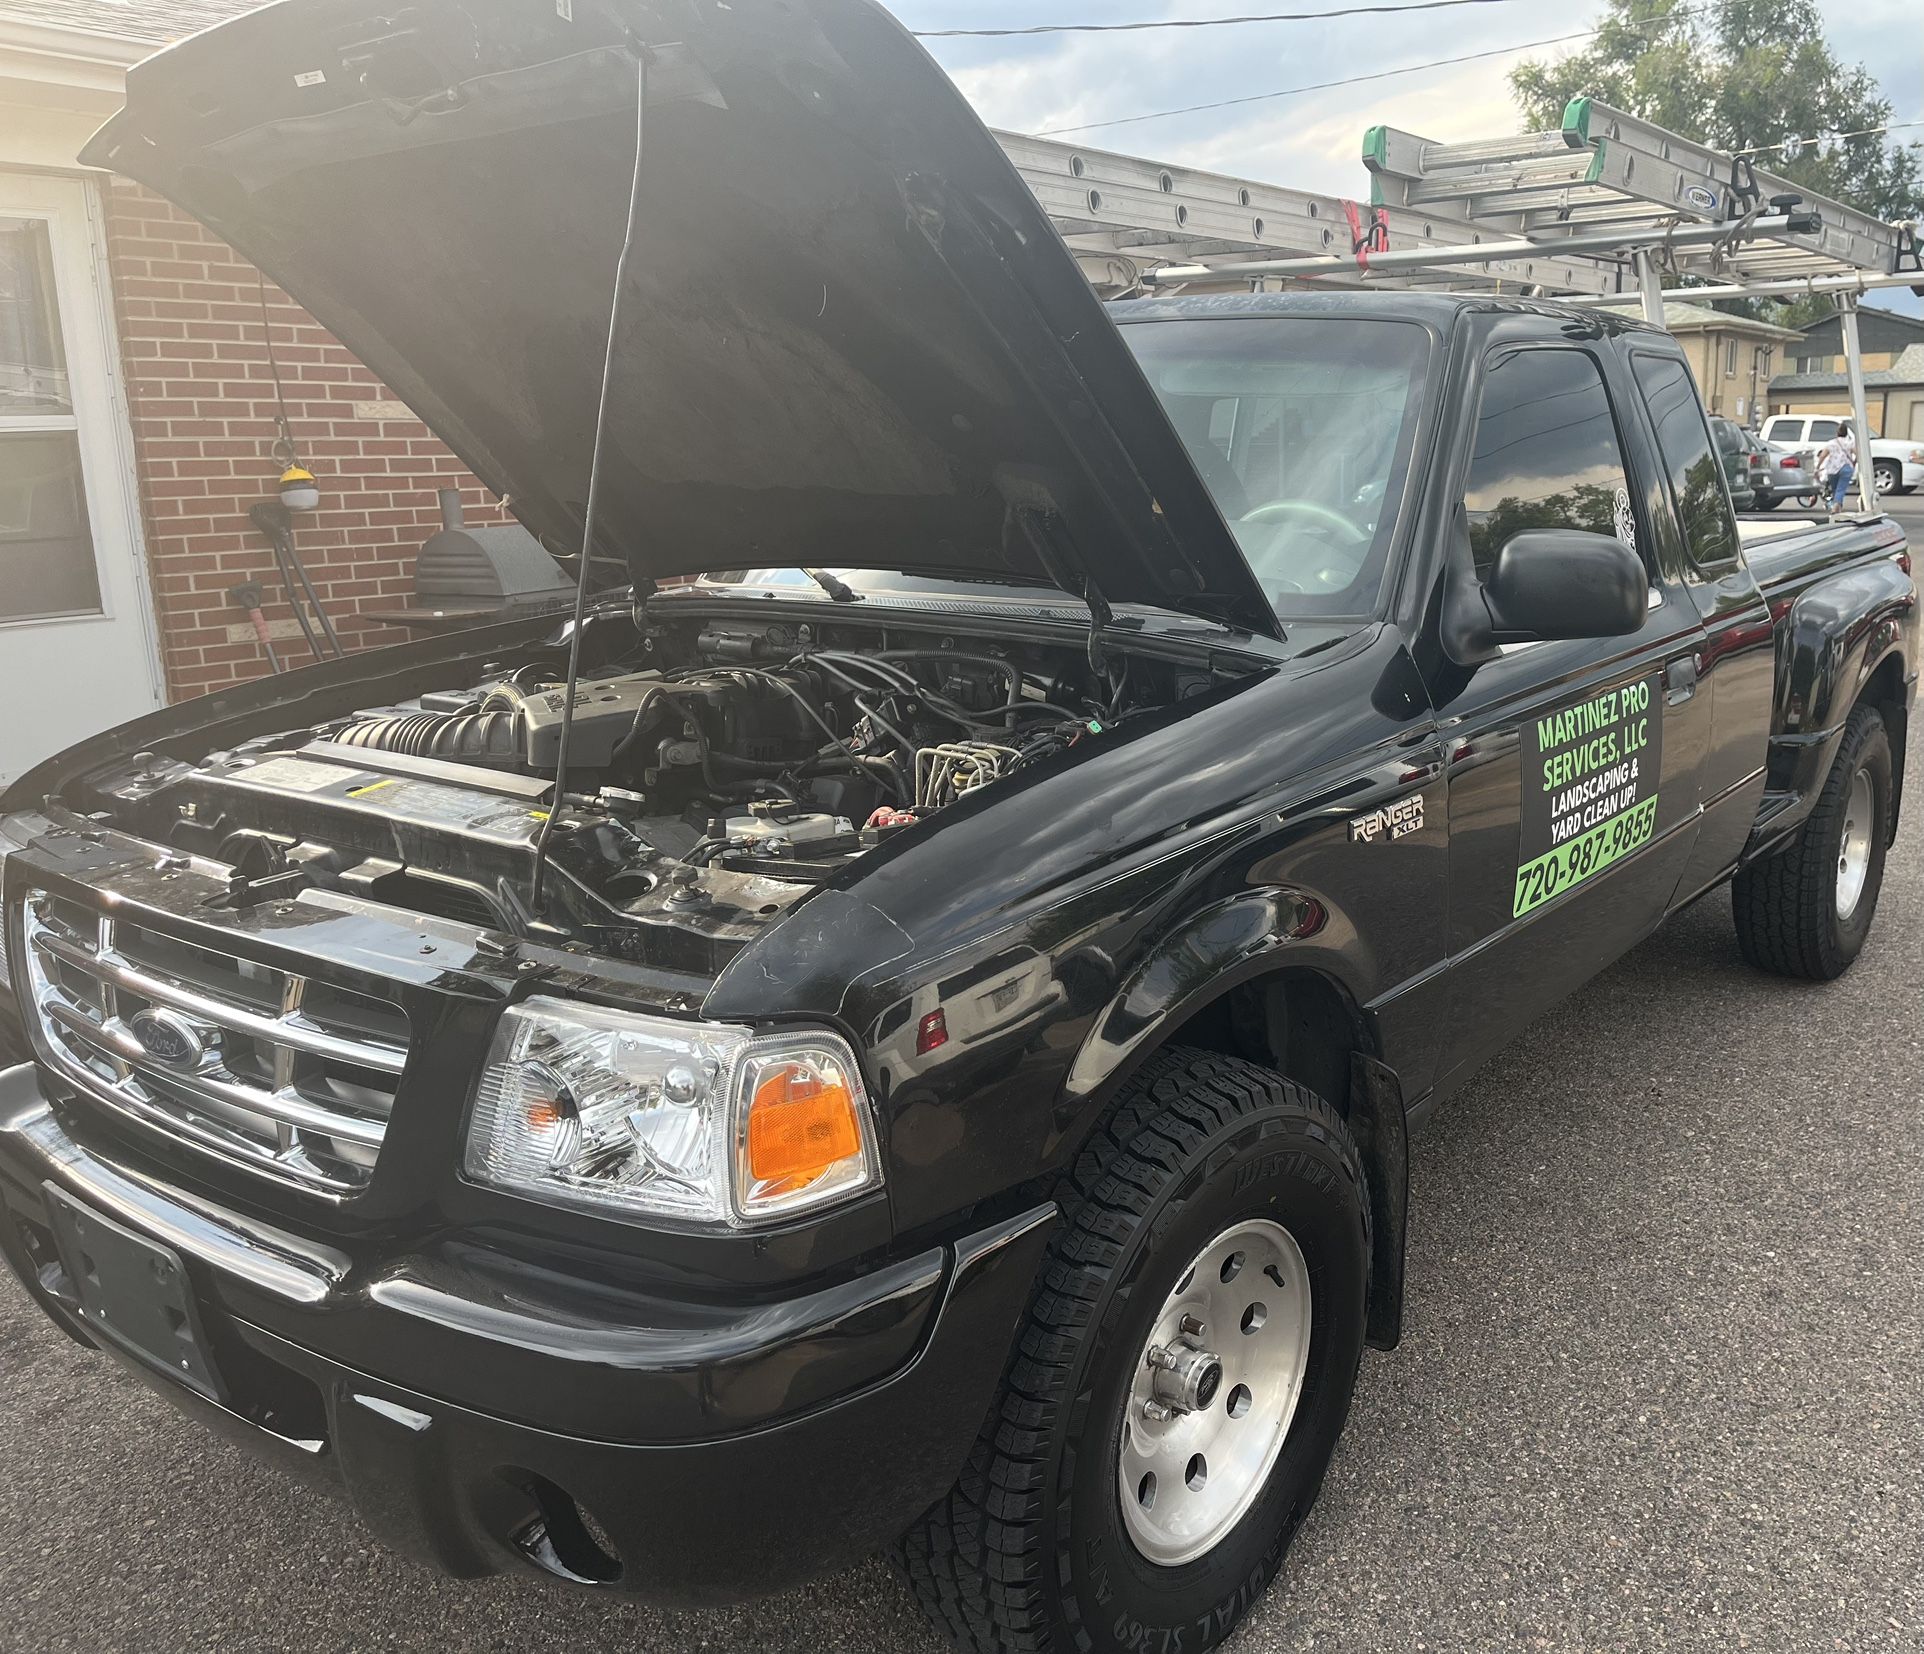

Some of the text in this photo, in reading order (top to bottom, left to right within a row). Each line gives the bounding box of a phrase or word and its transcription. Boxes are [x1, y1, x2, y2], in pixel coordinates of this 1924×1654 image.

[1537, 681, 1649, 752] MARTINEZ PRO
[1542, 718, 1648, 791] SERVICES, LLC
[1551, 782, 1637, 844] YARD CLEAN UP!
[1552, 758, 1639, 818] LANDSCAPING &
[1396, 817, 1422, 836] XLT
[1515, 801, 1655, 913] 720-987-9855
